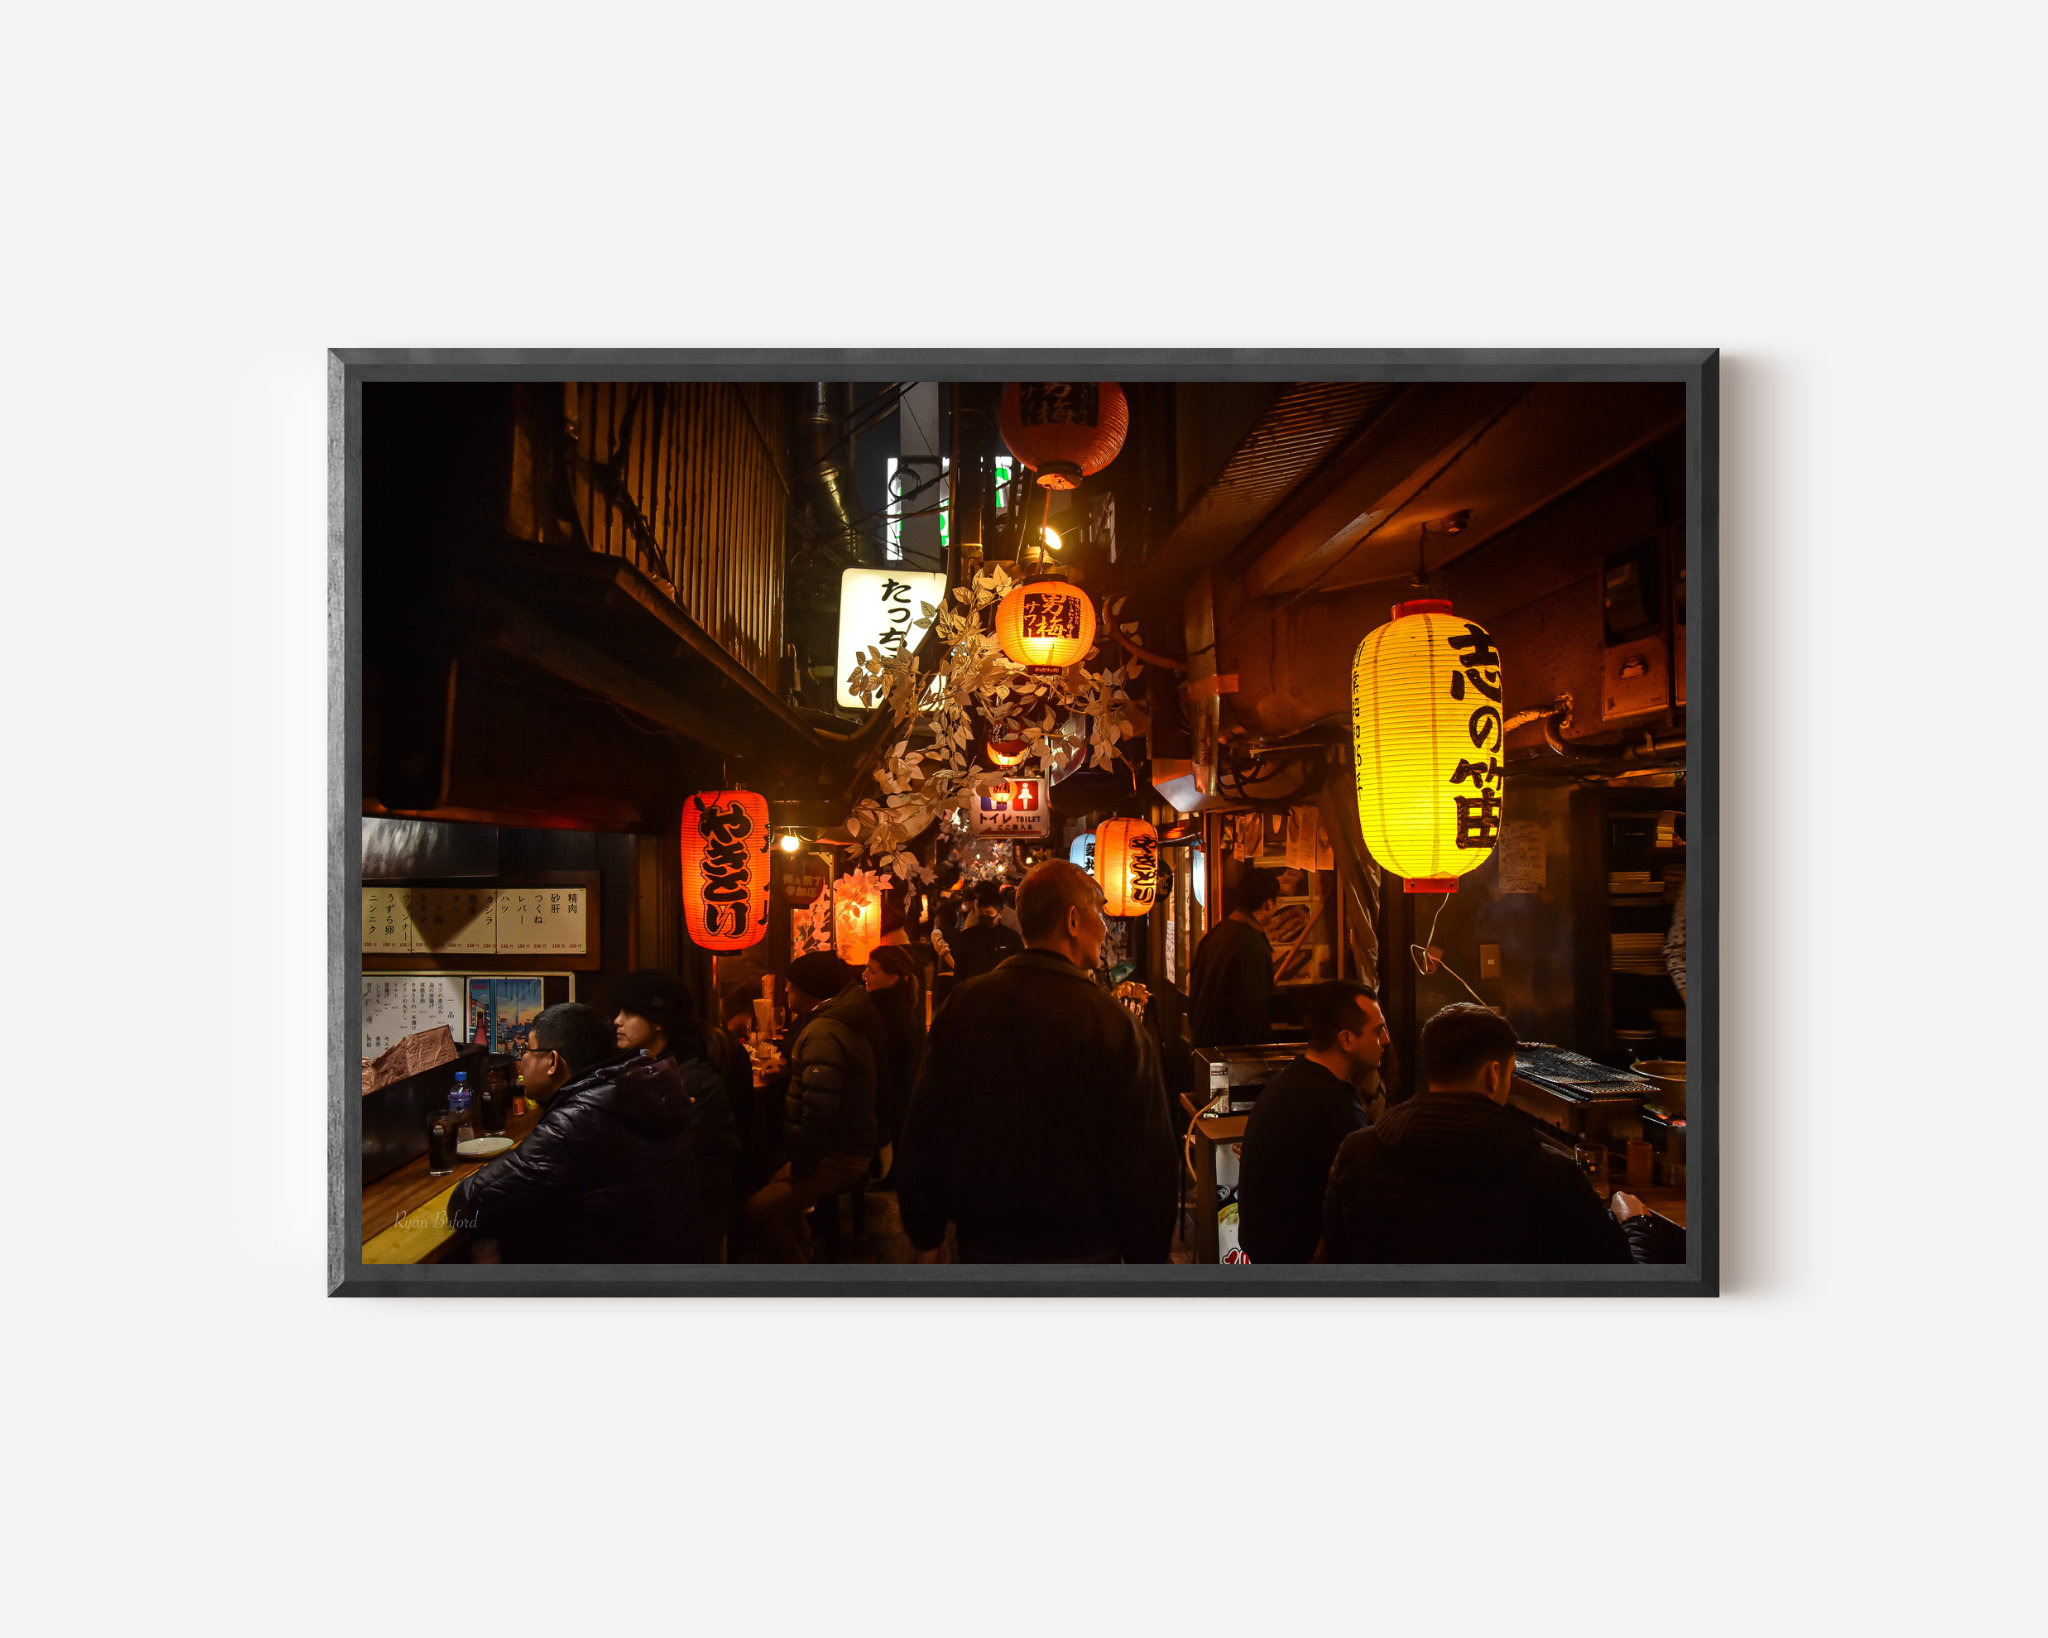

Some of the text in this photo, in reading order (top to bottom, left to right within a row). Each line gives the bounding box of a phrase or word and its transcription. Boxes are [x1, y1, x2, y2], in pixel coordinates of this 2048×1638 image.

[1035, 593, 1067, 638] 男梅
[980, 813, 1012, 824] トイレ
[698, 801, 754, 939] やきとり
[1129, 834, 1158, 905] やきとり
[369, 895, 378, 935] ニンニク
[384, 893, 395, 935] うずら卵
[485, 895, 494, 926] カシラ
[500, 895, 510, 914] ハツ
[517, 895, 527, 925] レバー
[534, 894, 543, 924] つくね
[550, 893, 561, 914] 砂肝
[567, 892, 577, 914] 精肉
